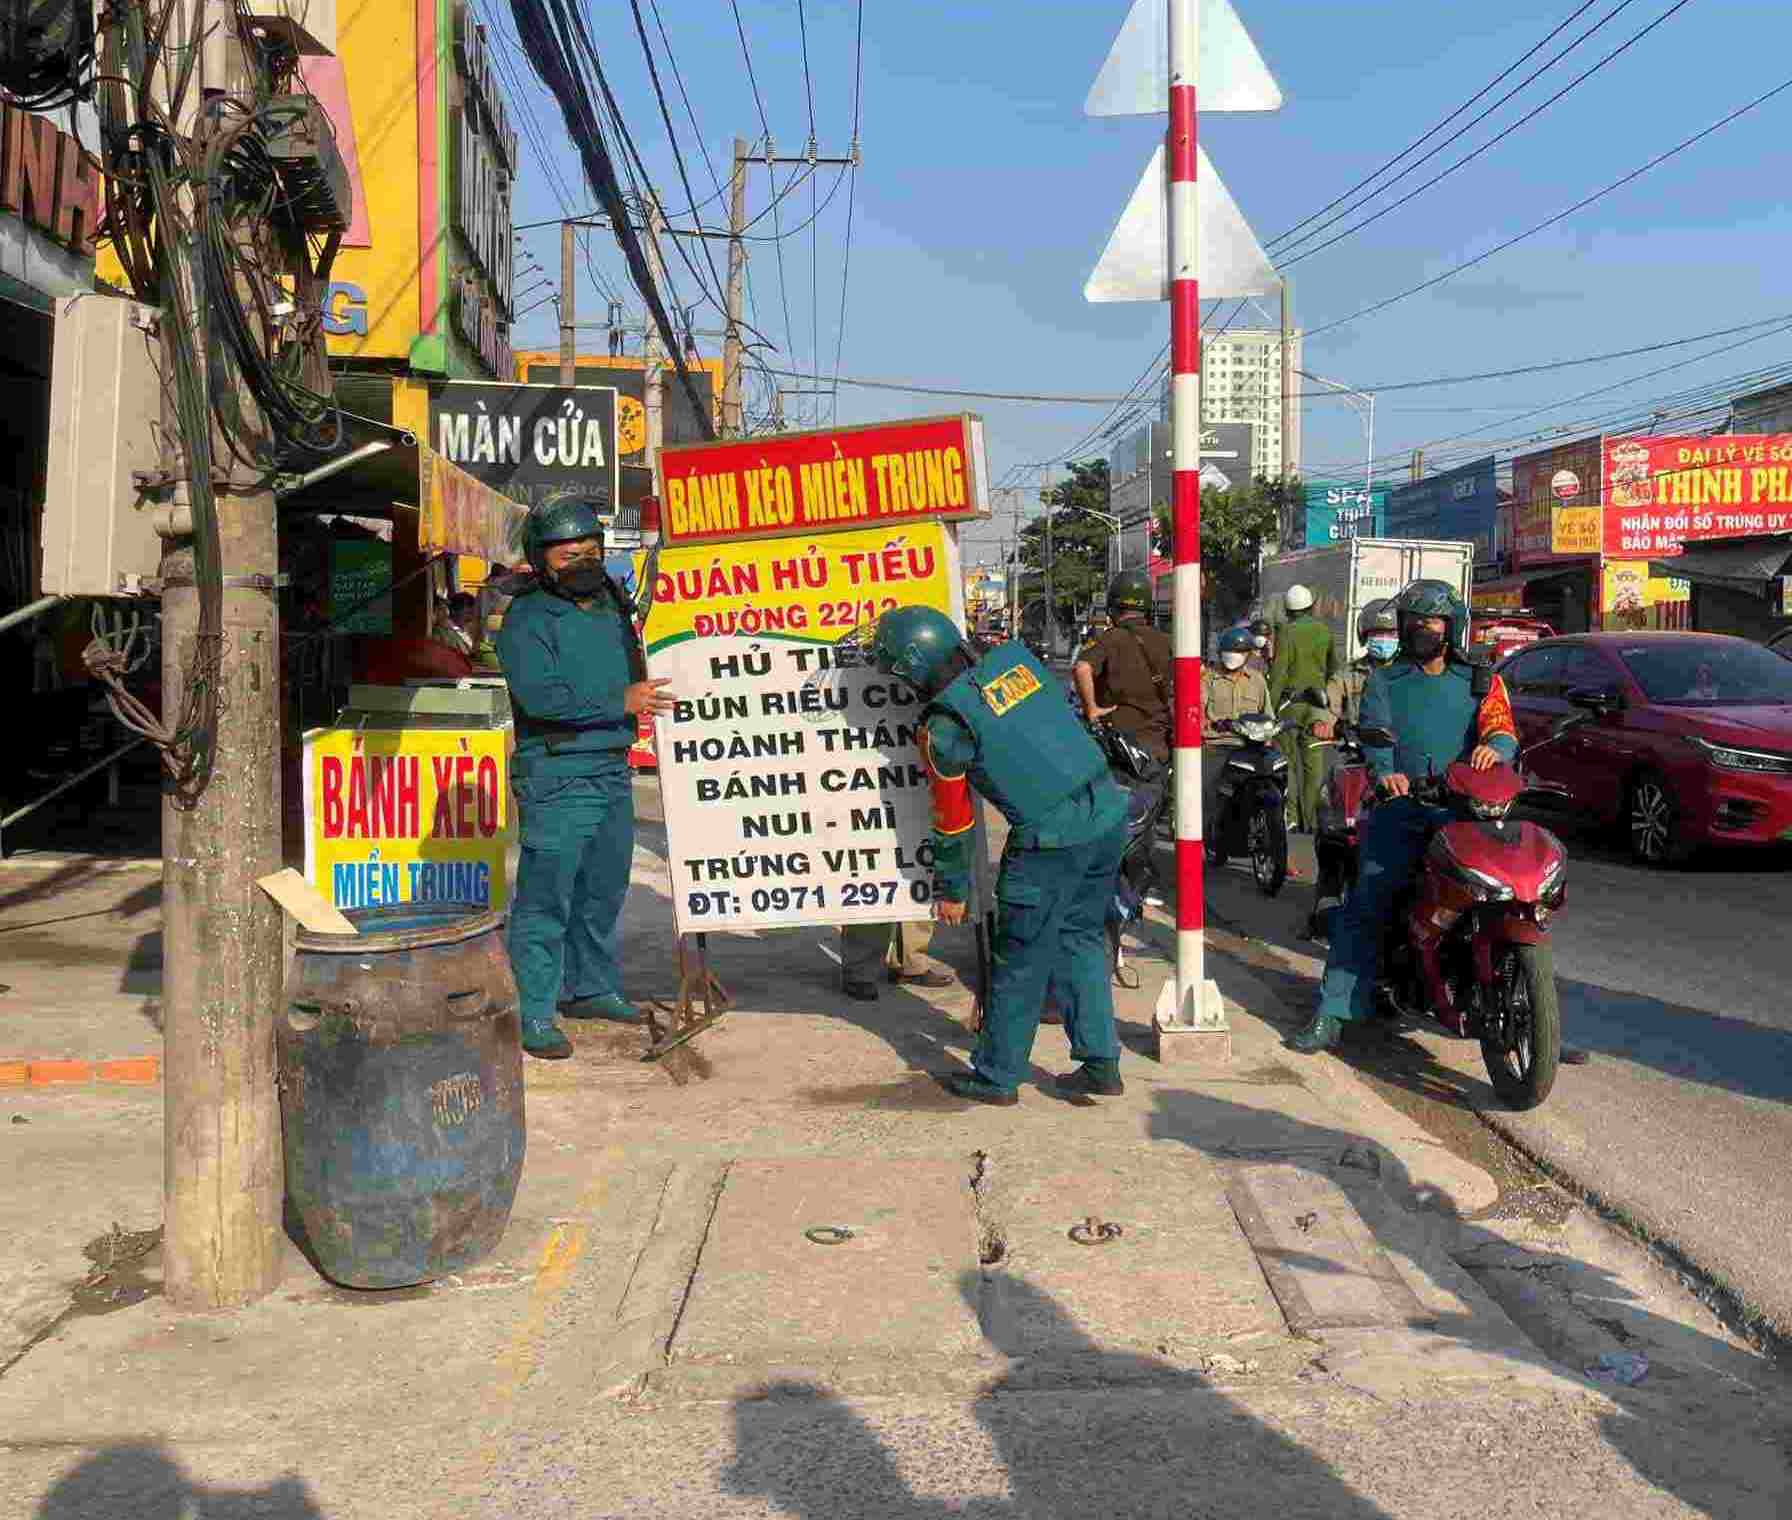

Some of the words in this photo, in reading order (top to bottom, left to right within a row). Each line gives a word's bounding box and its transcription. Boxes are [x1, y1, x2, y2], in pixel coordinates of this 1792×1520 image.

[439, 399, 521, 464] MÀN
[533, 398, 606, 467] CỬA
[1678, 448, 1710, 467] ĐẠI
[668, 467, 740, 536] BÁNH
[744, 459, 795, 528] XÈO
[800, 440, 868, 521] MIỀN
[872, 447, 966, 514] TRUNG
[1656, 467, 1742, 513] THỊNH
[1751, 467, 1792, 504] PH
[653, 558, 760, 603] QUÁN
[772, 545, 829, 591] HỦ
[841, 536, 936, 586] TIẾU
[694, 601, 808, 637] ĐƯỜNG
[710, 644, 772, 680] HỦ
[673, 691, 748, 723] BÚN
[760, 683, 849, 716] RIÊU
[862, 682, 918, 709] CU
[673, 731, 804, 763] HOÀNH
[816, 719, 918, 752] THÁN
[321, 736, 420, 839] BÁNH
[431, 737, 498, 839] XÈO
[696, 770, 807, 802] BÁNH
[742, 811, 812, 838] NUI
[850, 801, 896, 831] MÌ
[684, 850, 810, 881] TRỨNG
[822, 849, 880, 877] VỊT
[895, 838, 935, 875] LỘ
[407, 861, 490, 906] TRUNG
[687, 891, 741, 915] ĐT:
[751, 885, 825, 912] 0971
[841, 881, 898, 907] 297
